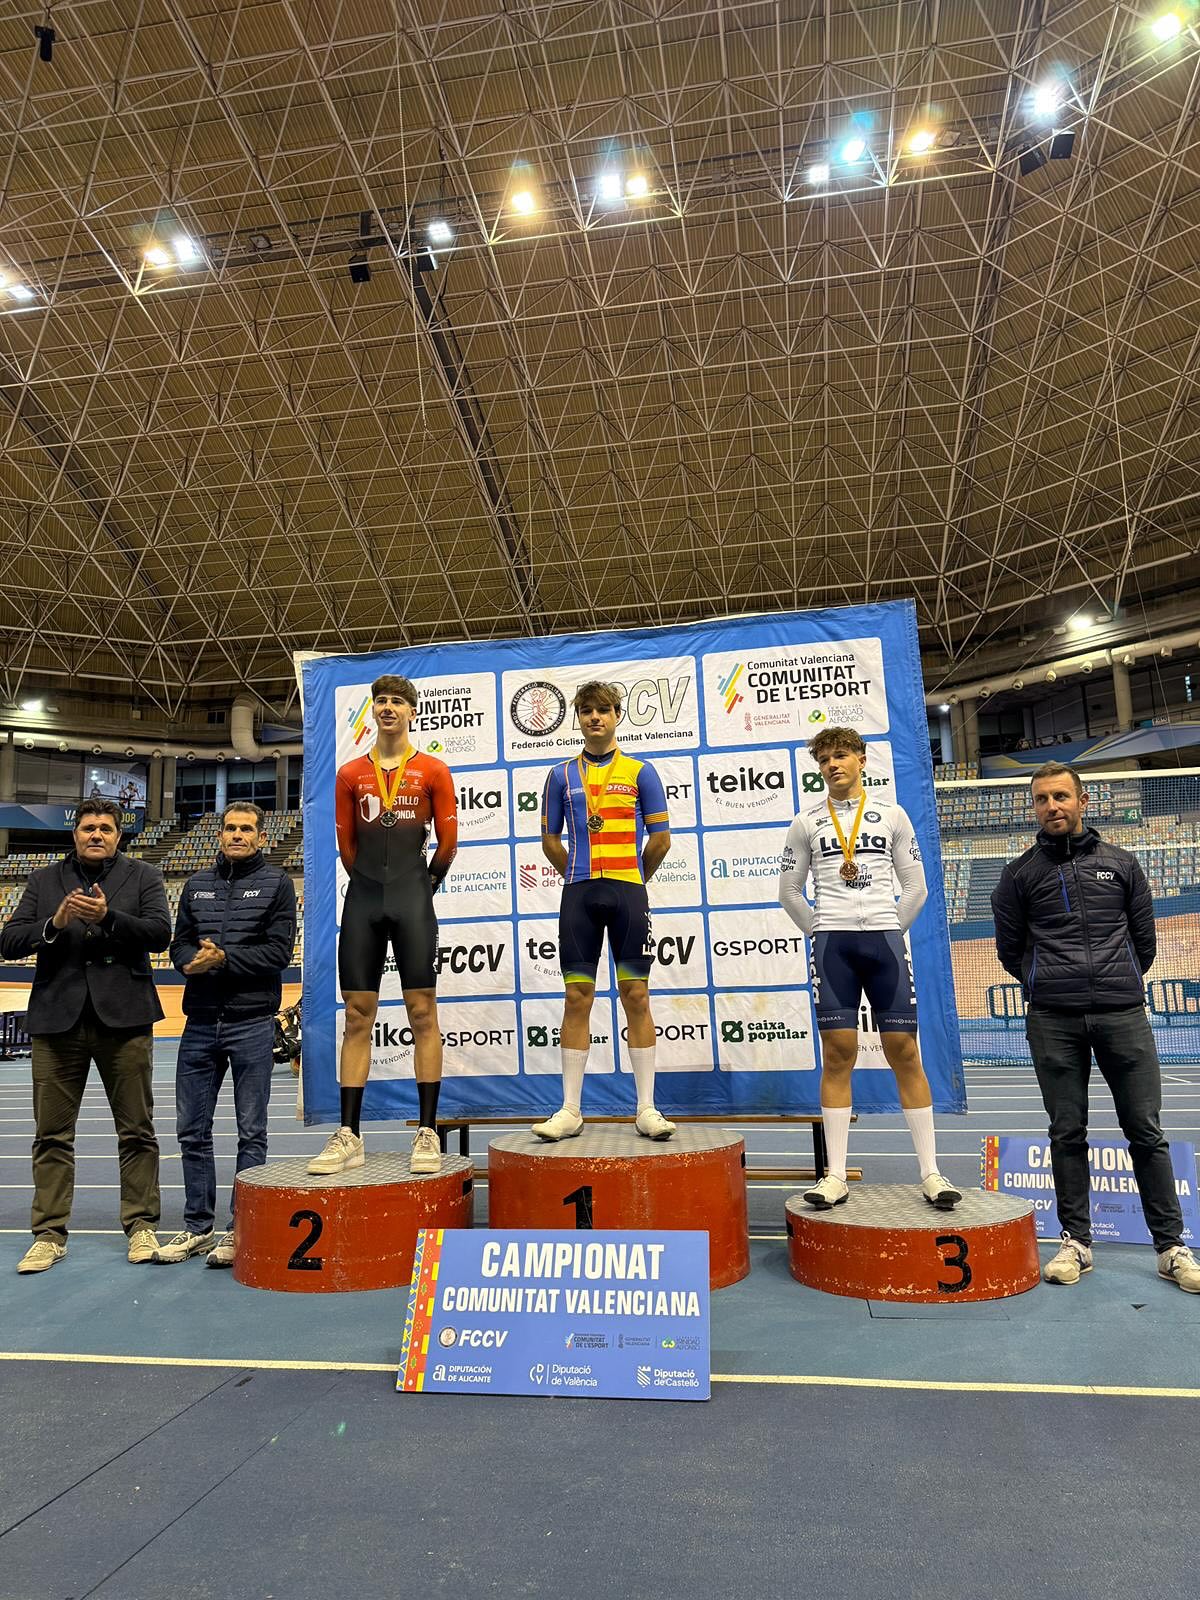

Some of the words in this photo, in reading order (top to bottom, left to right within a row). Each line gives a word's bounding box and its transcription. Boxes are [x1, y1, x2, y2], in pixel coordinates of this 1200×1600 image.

[748, 658, 798, 670] Comunitat
[800, 653, 855, 665] Valenciana
[747, 665, 855, 688] COMUNITAT
[423, 686, 471, 698] Valenciana
[757, 688, 780, 704] DE
[416, 697, 472, 716] UNITAT
[511, 739, 554, 750] Federació
[645, 730, 694, 741] Valenciana
[707, 767, 786, 793] teika
[725, 800, 745, 809] BUEN
[746, 793, 779, 809] VENDING
[466, 812, 496, 827] VENDING
[450, 870, 506, 882] DIPUTACIÓN
[655, 872, 696, 883] València
[733, 870, 745, 878] DE
[1096, 871, 1115, 880] FCCV
[450, 885, 462, 893] DE
[464, 882, 507, 893] ALICANTE
[713, 937, 802, 956] GSPORT
[437, 943, 505, 974] FCCV
[747, 1020, 785, 1031] caixa
[749, 1030, 808, 1042] popular
[380, 1050, 411, 1065] VENDING
[1004, 1172, 1056, 1190] COMUN
[563, 1185, 592, 1230] 1
[288, 1209, 323, 1271] 2
[481, 1241, 665, 1280] CAMPIONAT
[935, 1235, 972, 1293] 3
[442, 1286, 560, 1313] COMUNITAT
[565, 1288, 700, 1317] VALENCIANA
[458, 1330, 508, 1348] FCCV
[448, 1364, 492, 1374] DIPUTACIÓN
[552, 1364, 592, 1376] Diputació
[654, 1369, 695, 1379] Diputació
[448, 1374, 457, 1382] DE
[459, 1375, 492, 1383] ALICANTE
[551, 1376, 562, 1386] de
[564, 1376, 598, 1387] València
